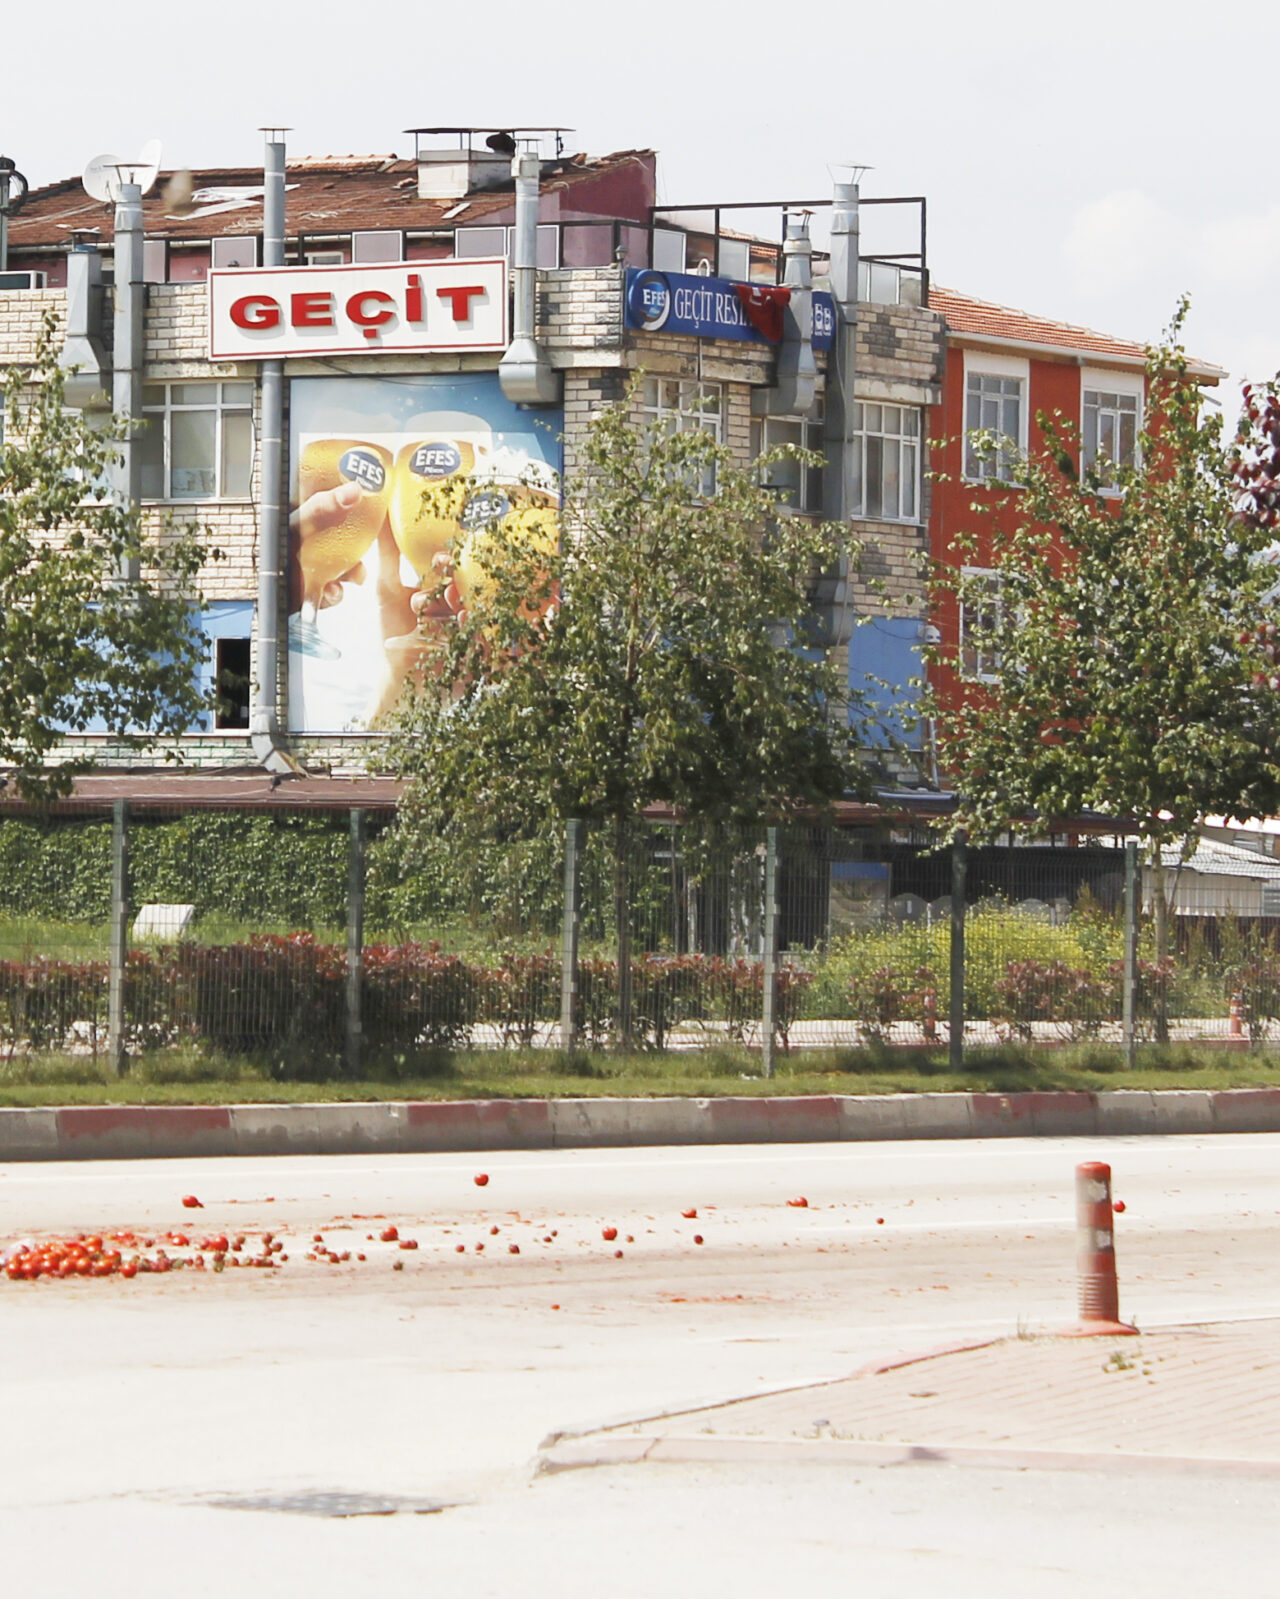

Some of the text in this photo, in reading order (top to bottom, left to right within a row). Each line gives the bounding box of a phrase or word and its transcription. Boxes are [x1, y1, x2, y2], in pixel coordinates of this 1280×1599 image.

[229, 273, 485, 339] GEÇİT
[674, 285, 713, 329] GEÇİT
[346, 453, 383, 485] EFES
[416, 449, 455, 467] EFES
